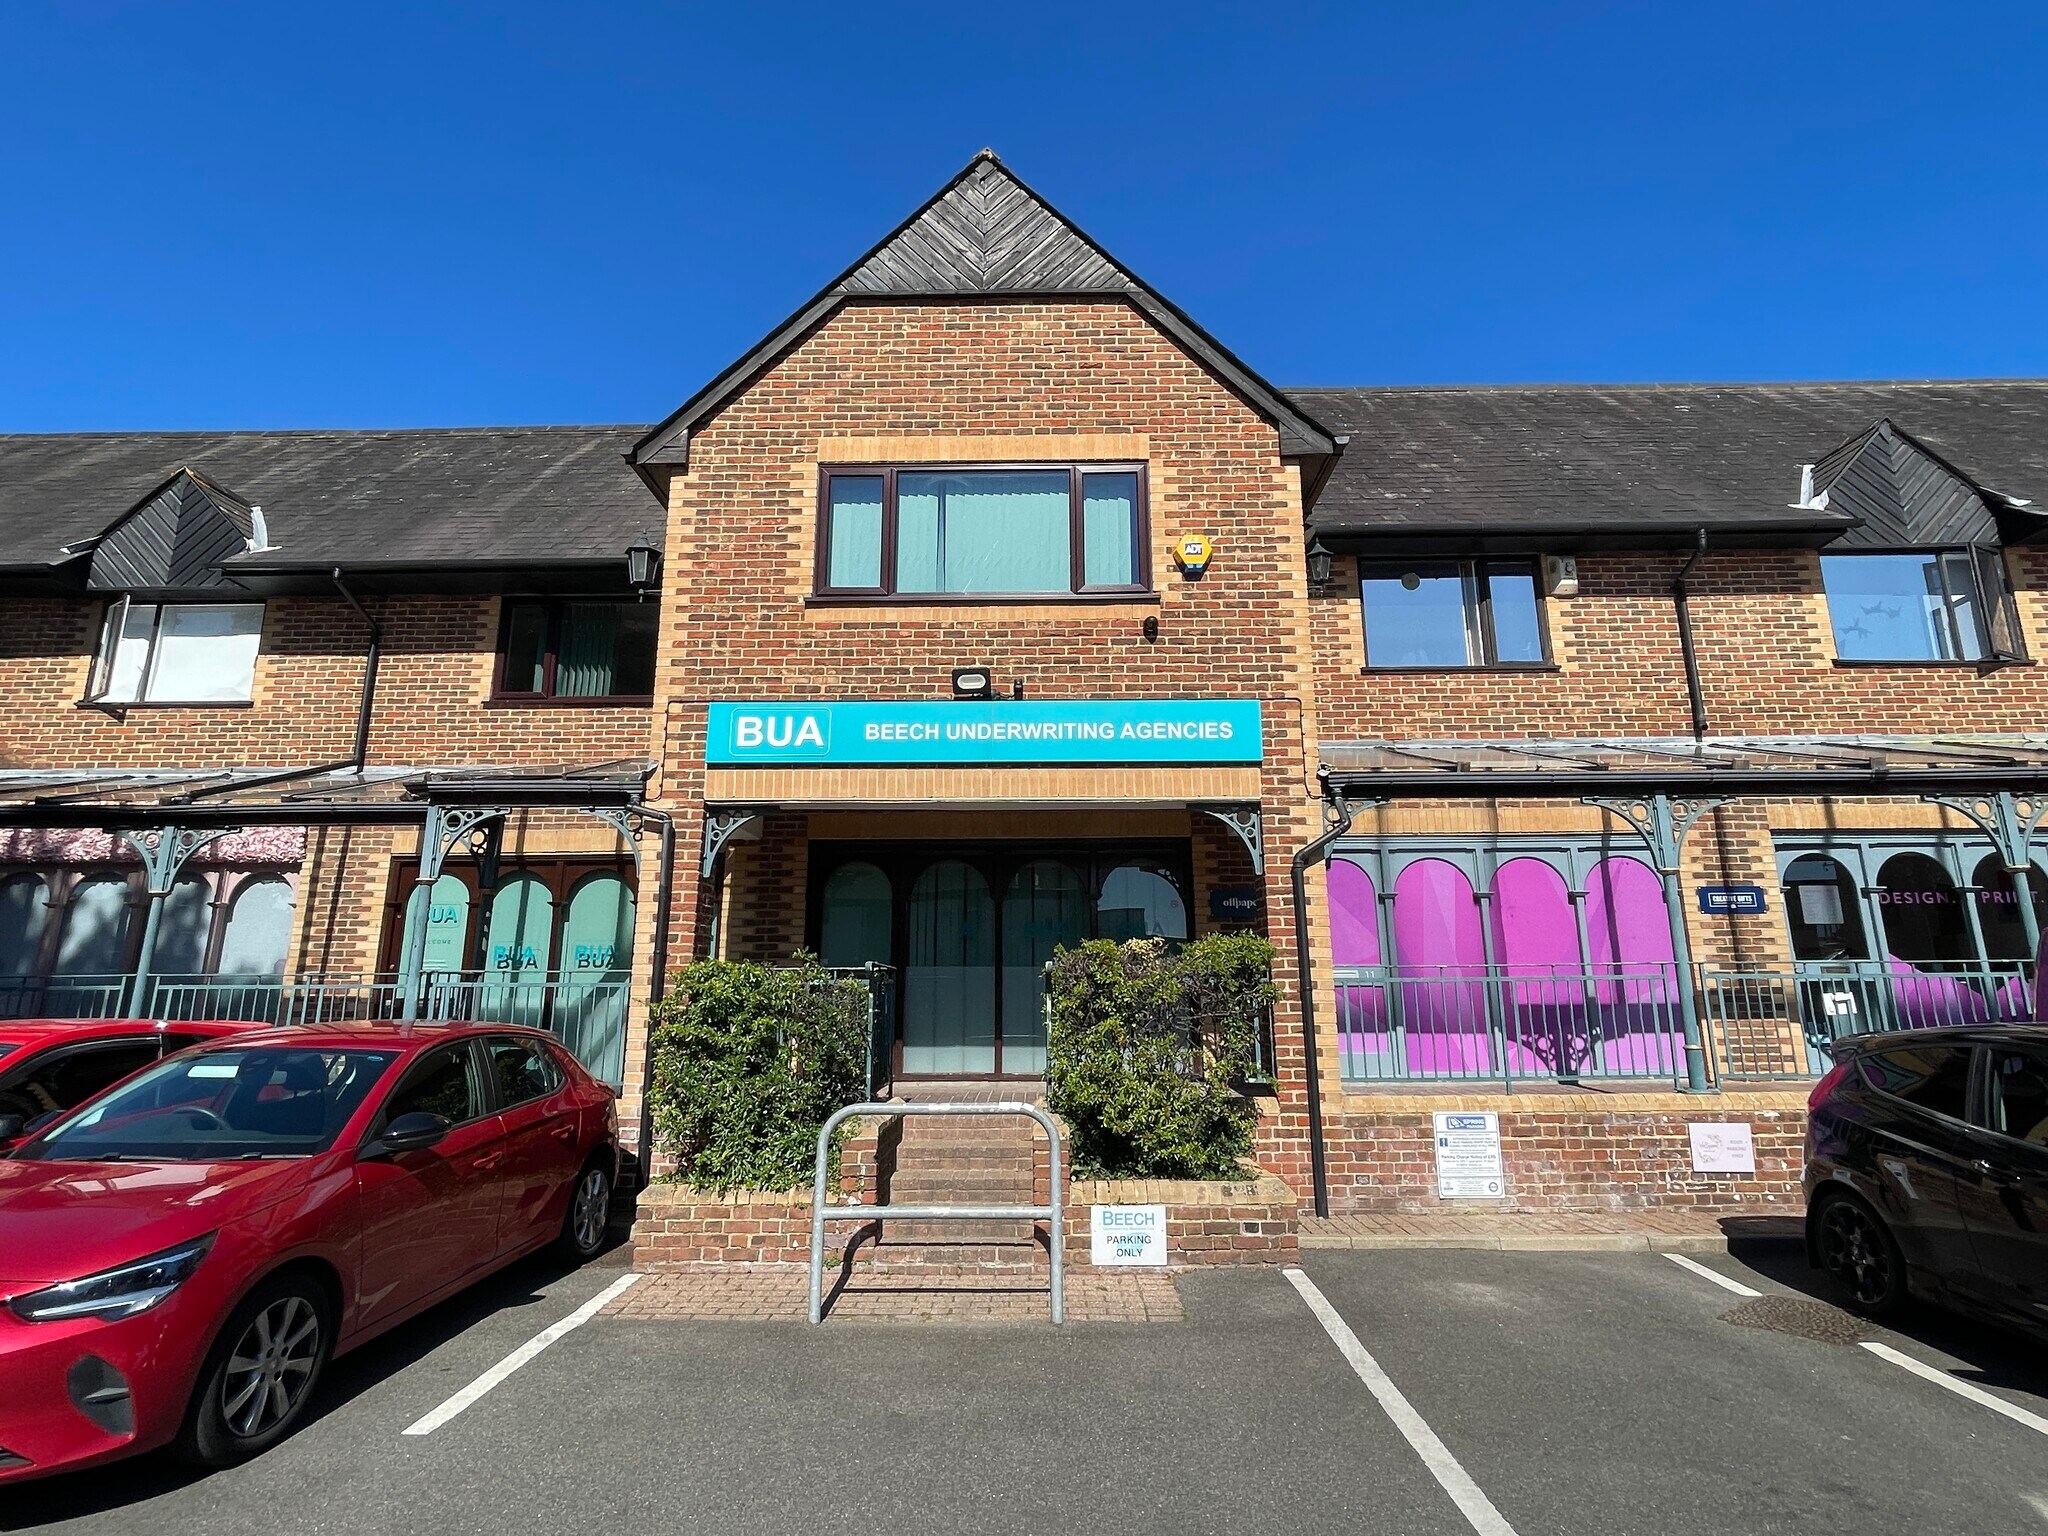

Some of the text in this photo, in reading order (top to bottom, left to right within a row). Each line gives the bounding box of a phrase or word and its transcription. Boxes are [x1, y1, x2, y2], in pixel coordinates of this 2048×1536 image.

[1185, 543, 1202, 555] ADT
[736, 716, 825, 747] BUA
[864, 721, 1233, 741] BEECH UNDERWRITING AGENCIES
[1981, 891, 2045, 904] PRIT.
[428, 906, 458, 923] UA
[1365, 970, 1376, 979] 11
[1103, 1211, 1155, 1225] BEECH
[1107, 1235, 1152, 1244] PARKING
[1116, 1248, 1143, 1257] ONLY
